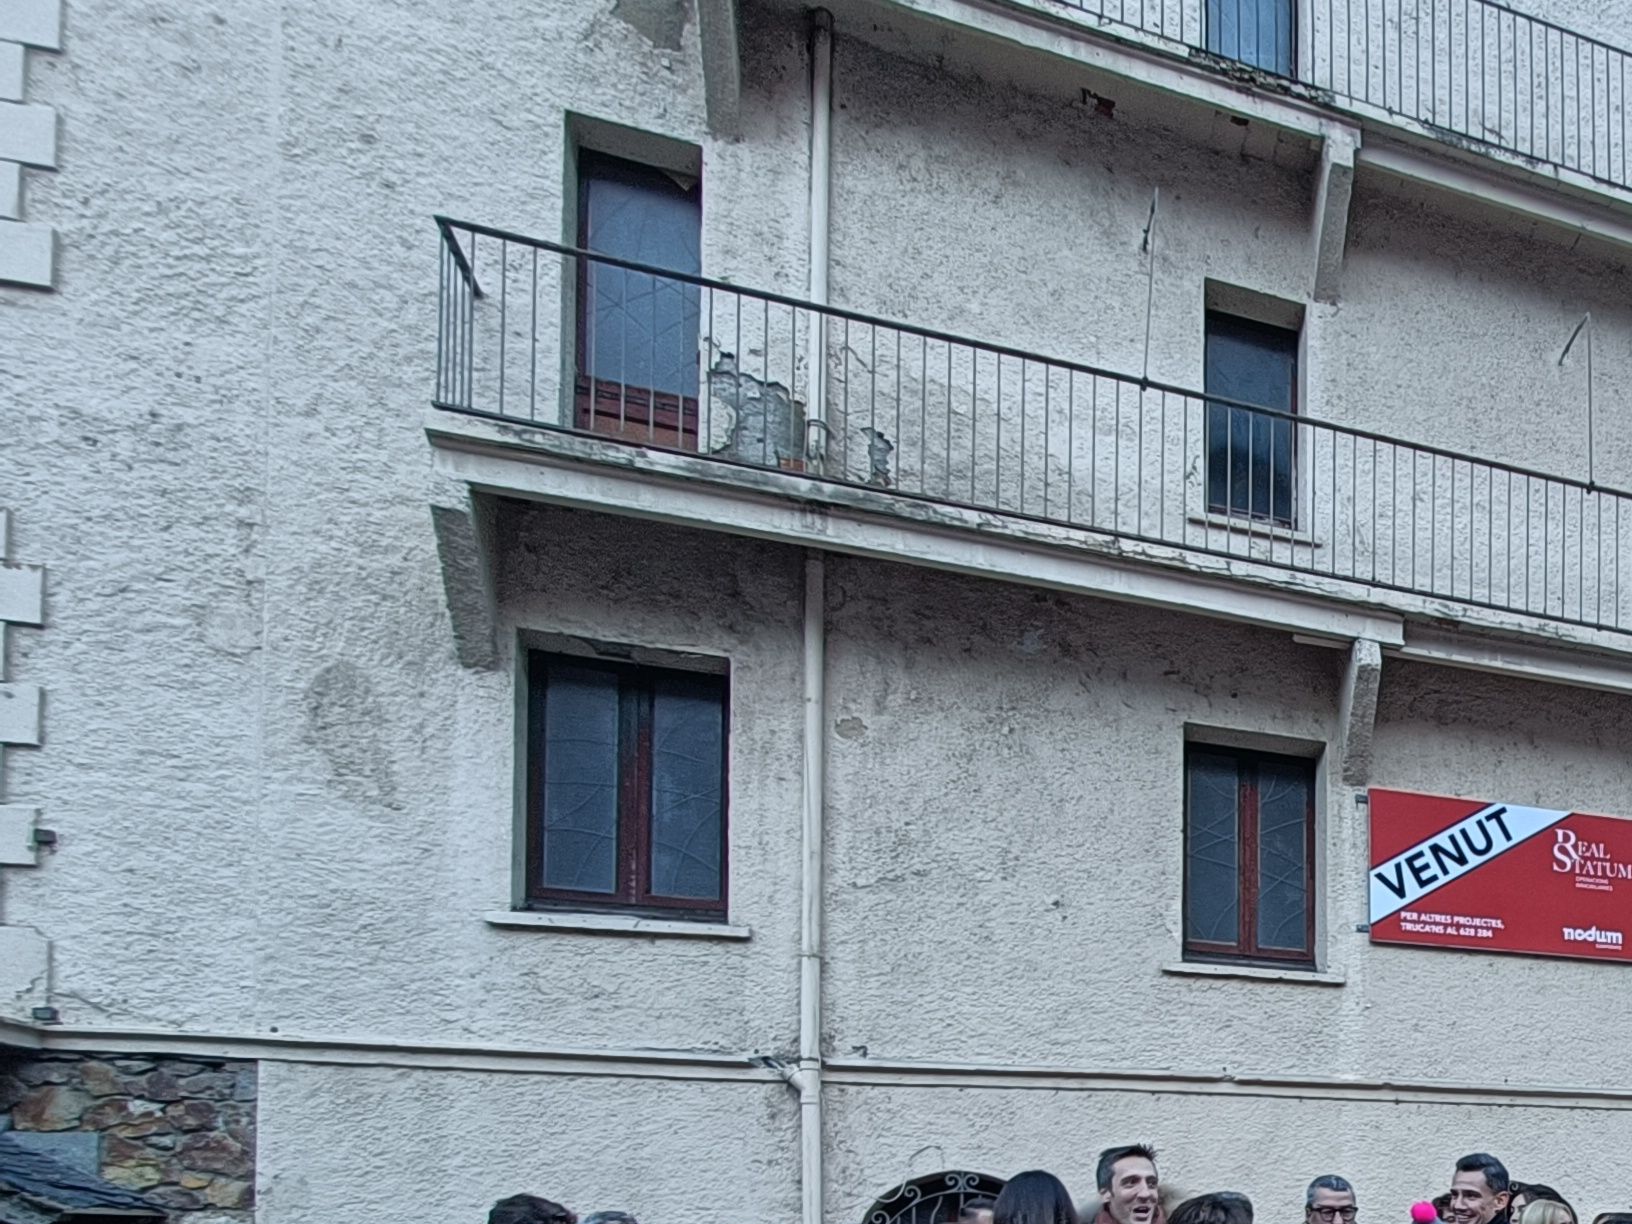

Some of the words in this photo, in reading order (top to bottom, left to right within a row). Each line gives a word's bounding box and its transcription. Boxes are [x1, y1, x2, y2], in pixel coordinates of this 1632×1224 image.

[1374, 806, 1513, 900] VENUT
[1554, 828, 1611, 860] REAL
[1552, 843, 1632, 879] STATUM
[1400, 911, 1418, 921] PER
[1420, 913, 1451, 924] ALTRES
[1446, 926, 1458, 935] AL
[1562, 925, 1623, 945] nodum
